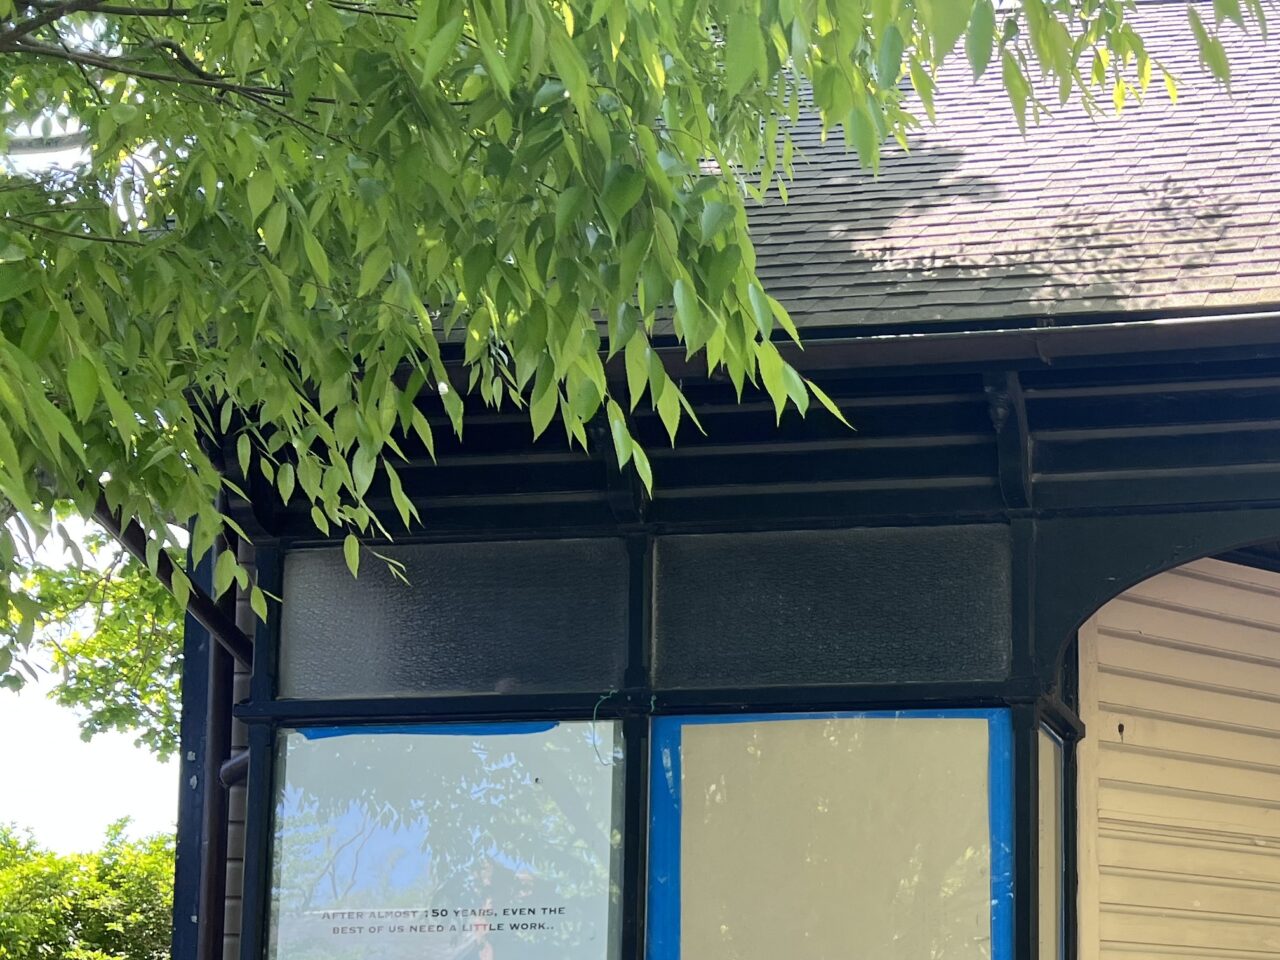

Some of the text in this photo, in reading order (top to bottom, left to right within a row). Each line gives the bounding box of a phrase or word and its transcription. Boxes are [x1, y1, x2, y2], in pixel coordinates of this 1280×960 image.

[321, 911, 364, 920] AFTER
[368, 910, 418, 919] ALMOST
[502, 907, 536, 916] EVEN
[541, 907, 566, 915] THE
[332, 926, 364, 935] BEST
[368, 926, 384, 934] OF
[388, 925, 404, 934] US
[409, 924, 444, 933] NEED
[449, 924, 457, 932] A
[462, 923, 504, 932] LITTLE
